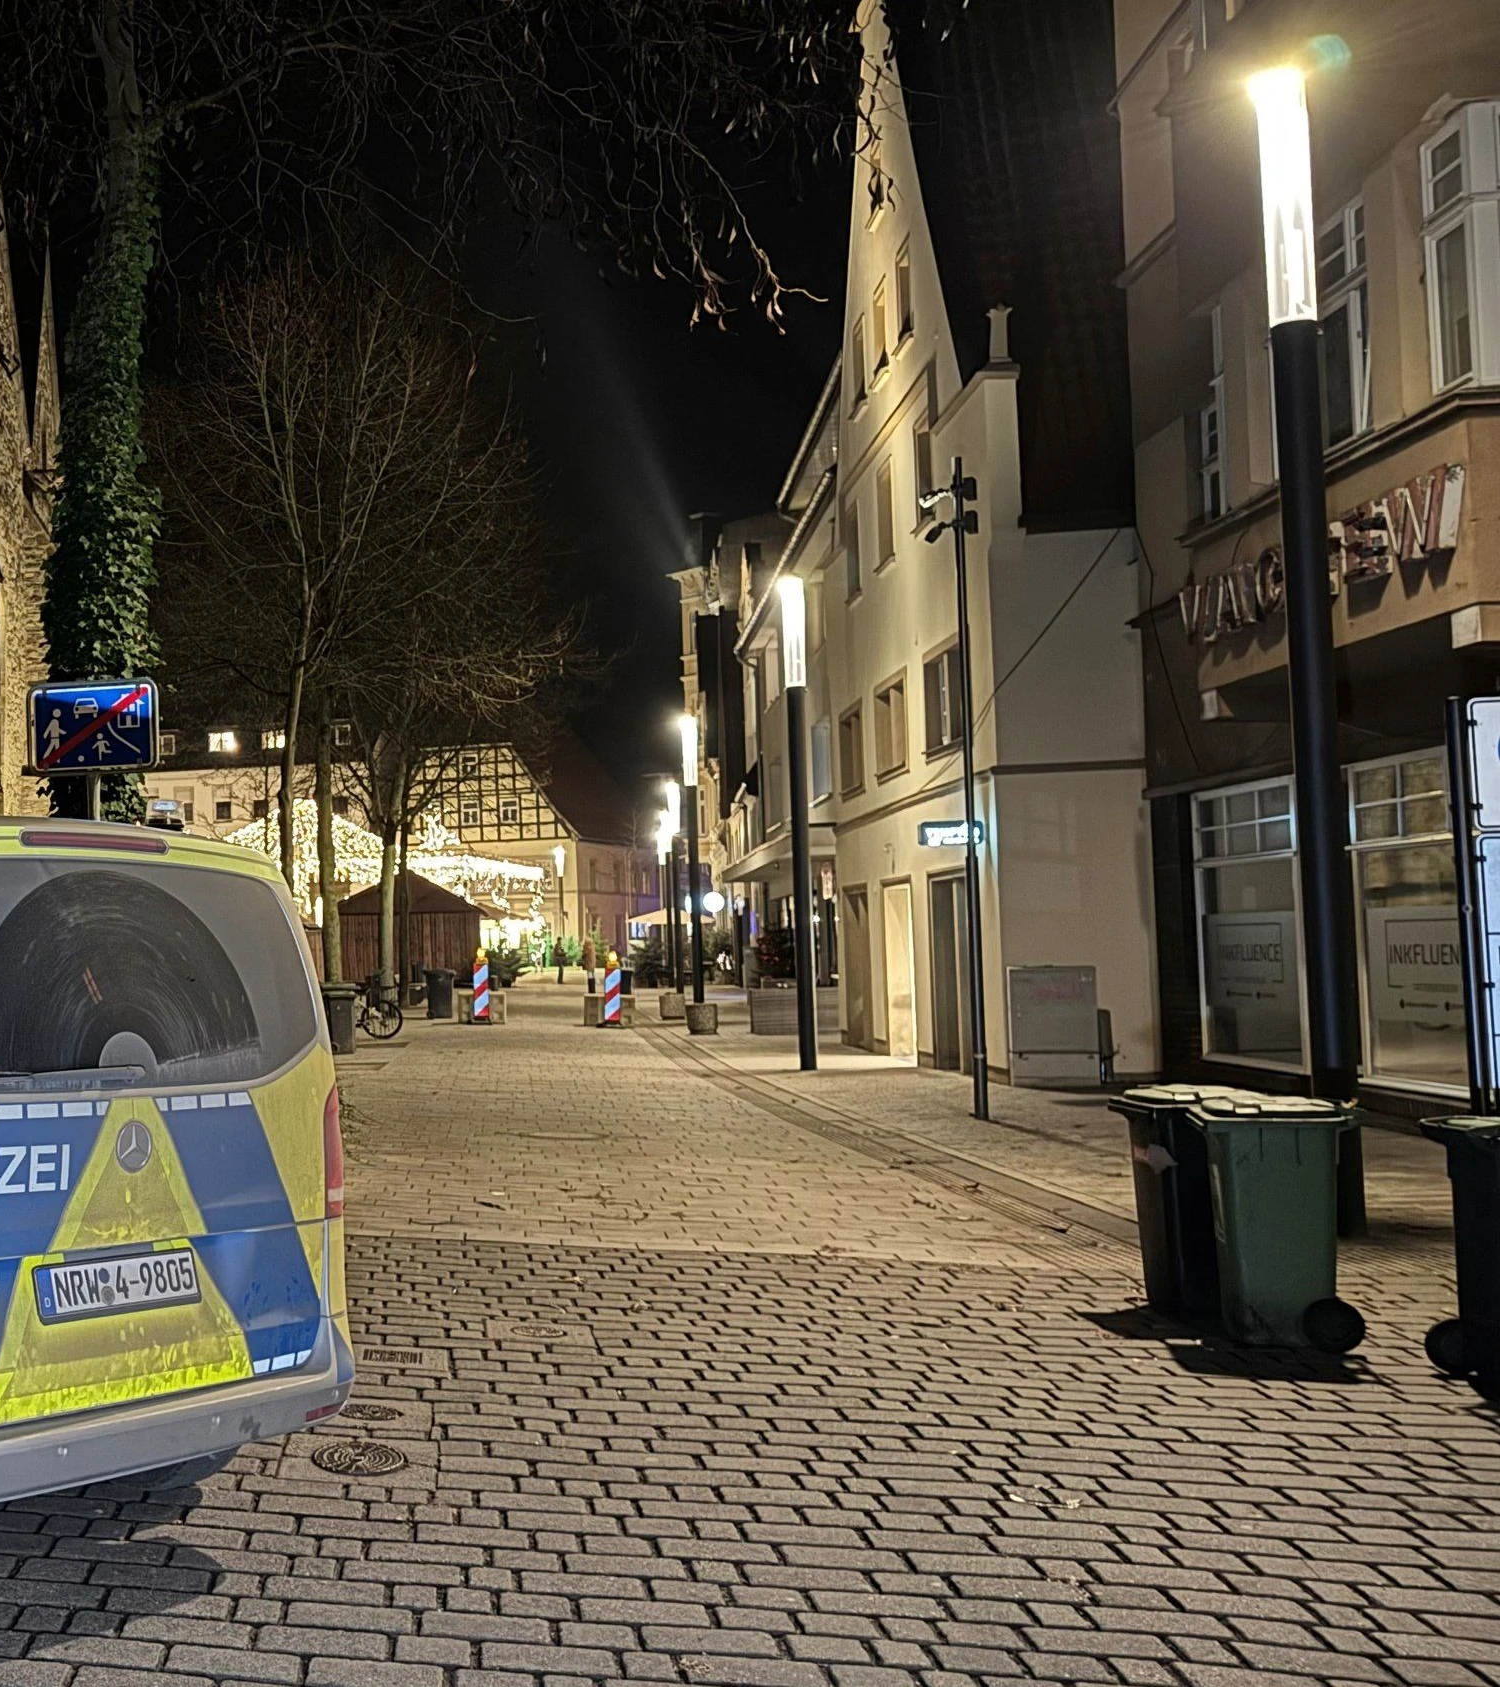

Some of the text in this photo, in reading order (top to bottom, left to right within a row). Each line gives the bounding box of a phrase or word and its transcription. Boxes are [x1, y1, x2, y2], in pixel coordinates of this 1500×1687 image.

[1388, 943, 1460, 966] INKFLUEN
[54, 1257, 193, 1307] NRW 4-9805
[44, 1296, 51, 1308] D
